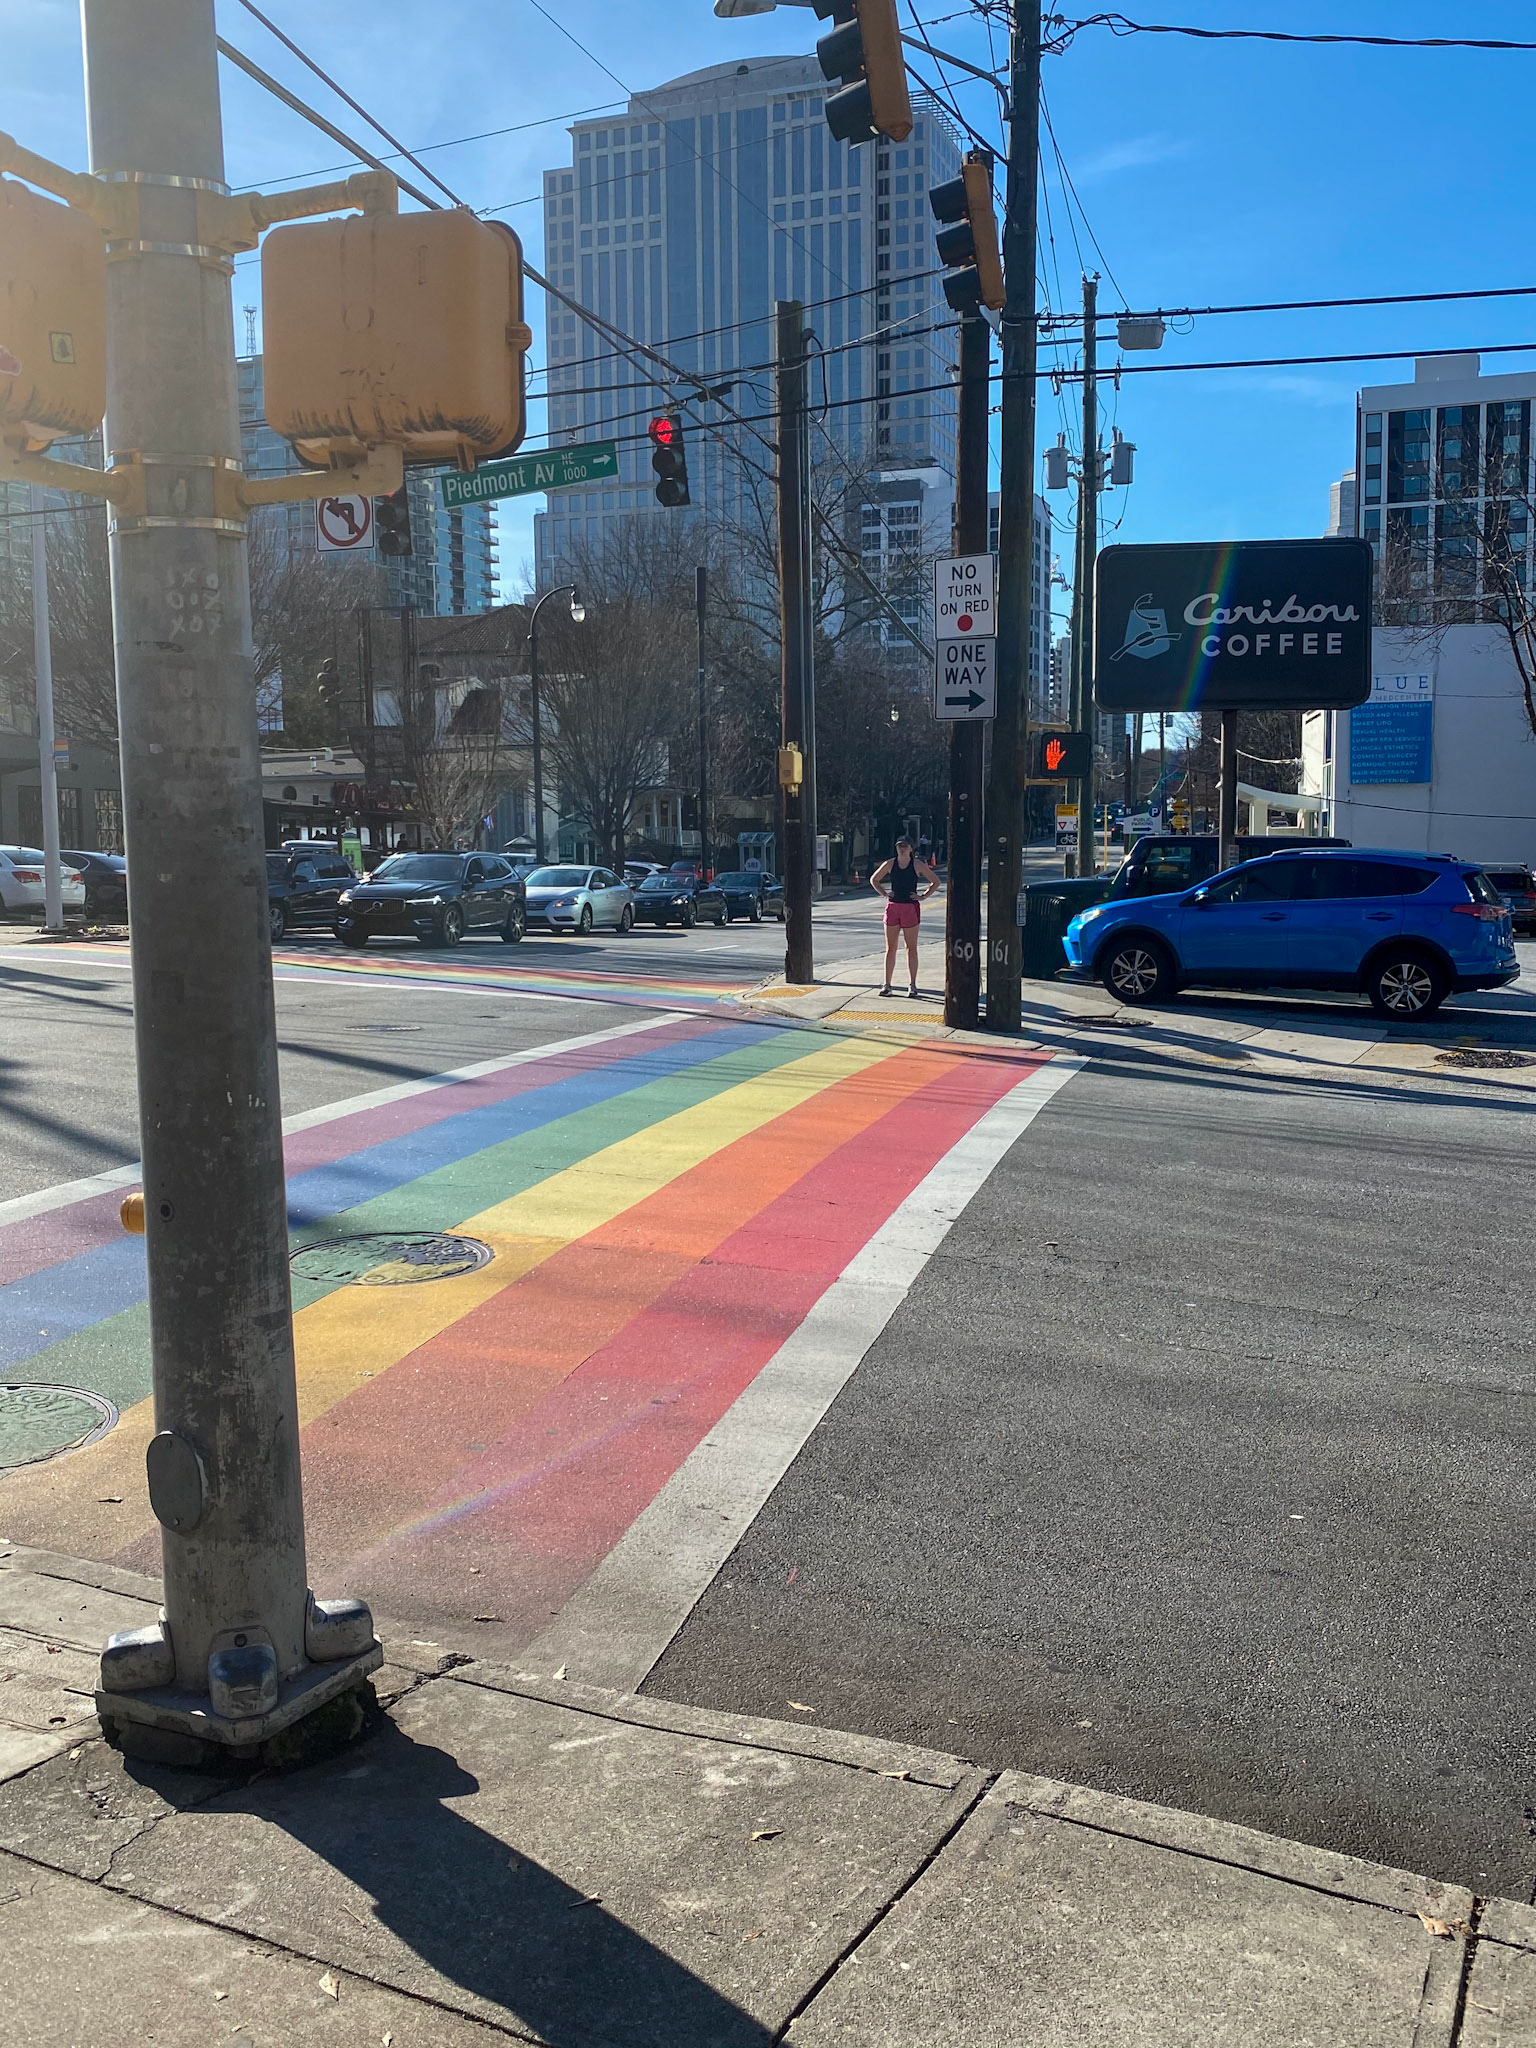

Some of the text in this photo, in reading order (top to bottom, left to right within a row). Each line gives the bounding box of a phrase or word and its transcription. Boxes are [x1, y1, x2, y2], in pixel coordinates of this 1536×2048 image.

[562, 452, 574, 465] NE
[563, 466, 587, 481] 1000
[446, 464, 555, 501] Piedmont Av
[952, 564, 976, 581] NO
[948, 583, 982, 598] TURN
[940, 600, 989, 615] ON RED
[1183, 593, 1360, 626] Caribou
[1201, 632, 1342, 657] COFFEE
[947, 645, 986, 663] ONE
[945, 667, 987, 685] WAY
[1375, 676, 1428, 690] LUE
[1152, 808, 1158, 816] P
